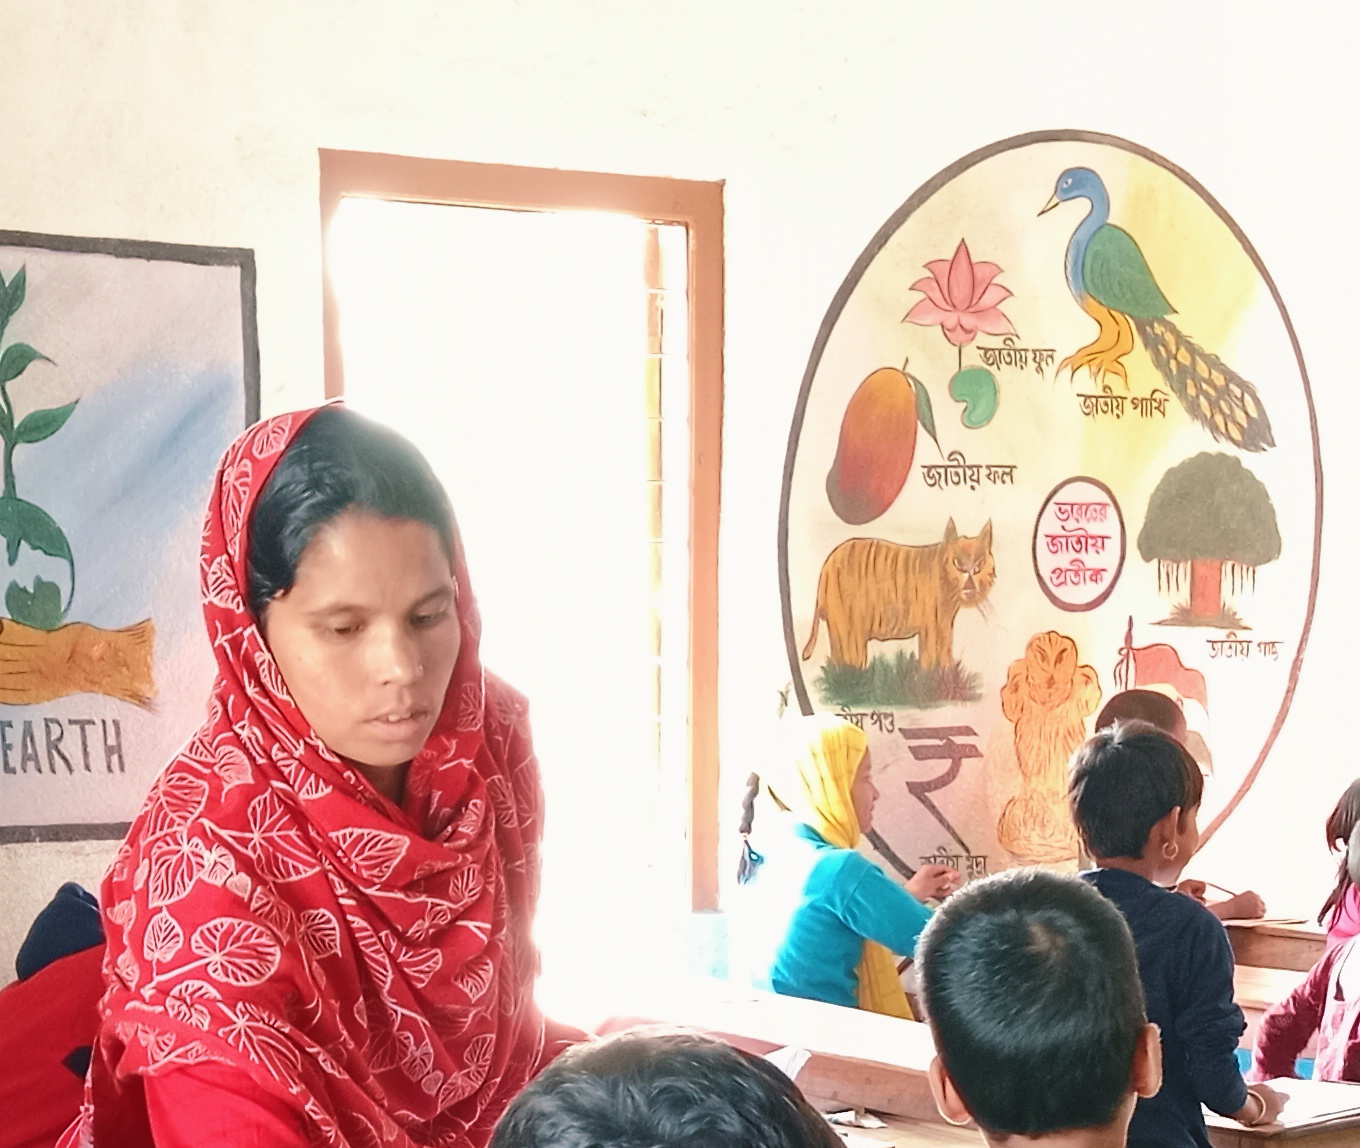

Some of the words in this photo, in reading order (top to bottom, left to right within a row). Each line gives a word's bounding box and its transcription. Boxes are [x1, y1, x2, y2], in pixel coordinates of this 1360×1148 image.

[976, 337, 1029, 371] জাতীয়
[1076, 384, 1127, 421] জাতীয়
[1131, 388, 1170, 418] পাখি
[921, 450, 983, 490] জাতীয়
[985, 464, 1017, 485] ফল
[1053, 502, 1110, 523] ভারতের
[1044, 525, 1112, 554] জাতীয়
[1050, 558, 1108, 588] প্রতীক
[0, 718, 126, 775] EARTH
